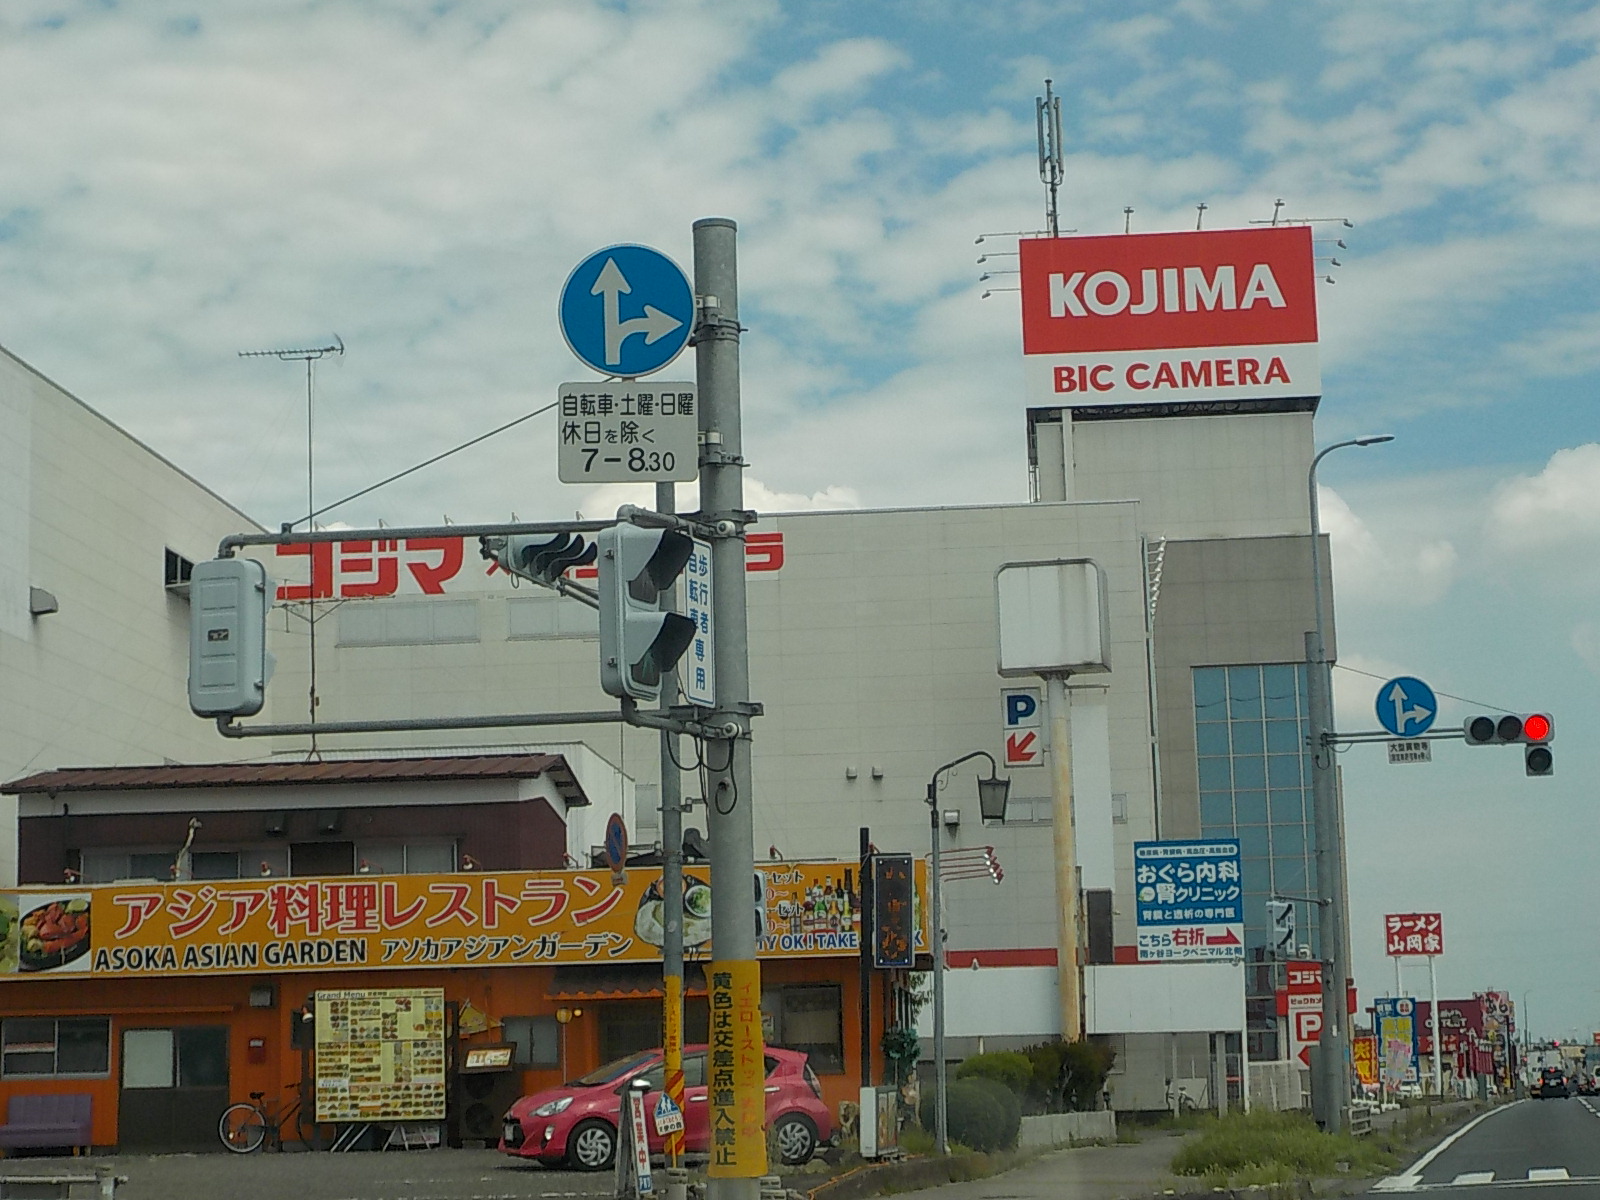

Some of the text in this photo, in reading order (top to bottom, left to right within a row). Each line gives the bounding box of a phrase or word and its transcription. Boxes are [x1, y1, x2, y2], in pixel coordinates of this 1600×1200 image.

[1049, 264, 1287, 318] KOJIMA
[1053, 357, 1291, 393] BIC CAMERA
[562, 421, 655, 444] 休日を除く
[1007, 695, 1036, 725] P
[1137, 861, 1240, 884] おぐら内科
[113, 876, 624, 939] アジア料理レストラン
[1388, 915, 1439, 933] ラーメン
[95, 937, 366, 971] ASOKA ASIAN GARDEN
[380, 931, 633, 962] アソカアジアンガーデン
[817, 932, 858, 949] TAKE
[1388, 933, 1441, 952] 山岡家
[1301, 1014, 1322, 1040] P
[713, 972, 737, 1166] 黄色は交差点進入禁止
